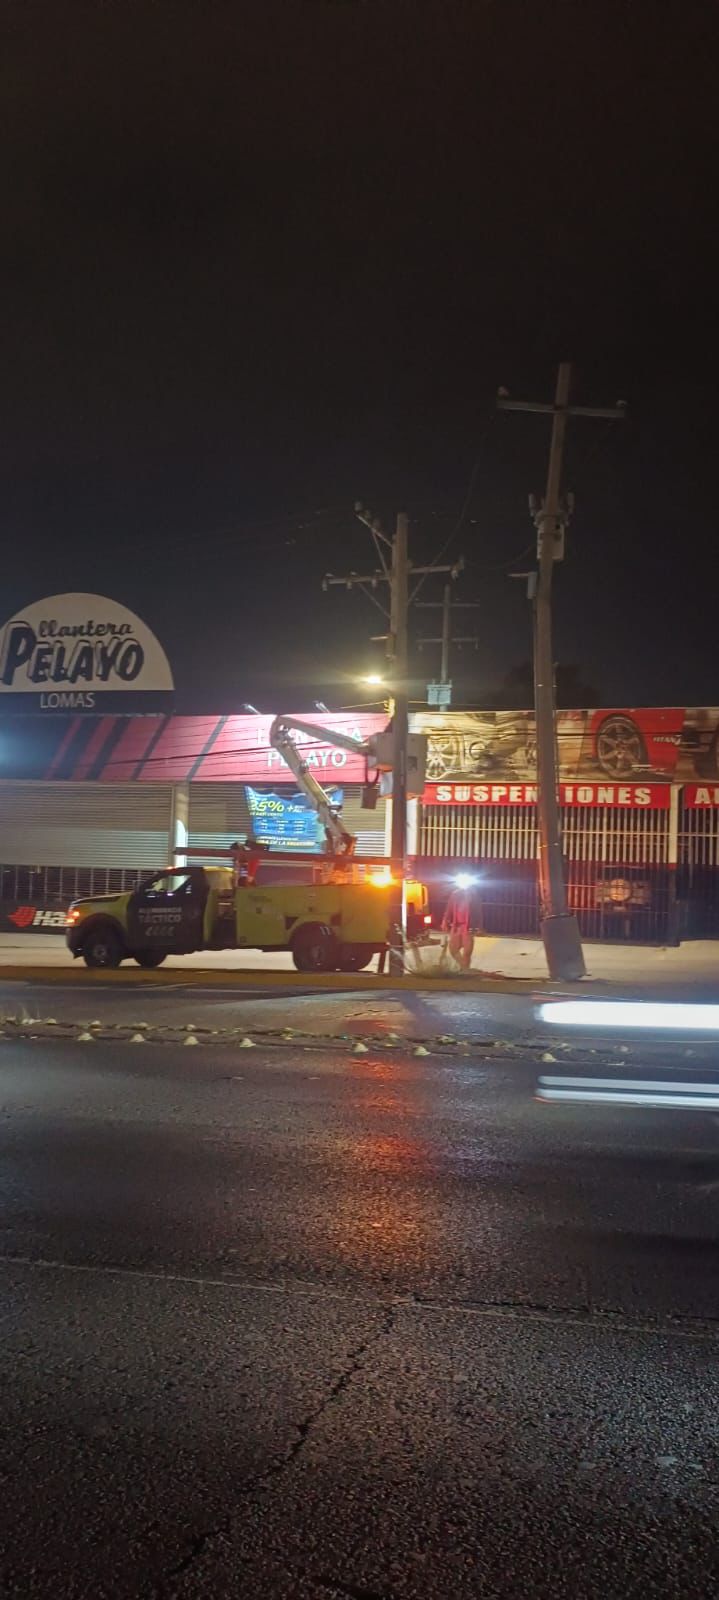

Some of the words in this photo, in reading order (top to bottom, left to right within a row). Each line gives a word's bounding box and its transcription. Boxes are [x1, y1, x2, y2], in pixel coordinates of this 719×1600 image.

[0, 621, 144, 685] PELAYO
[40, 693, 95, 708] LOMAS
[435, 785, 652, 805] SUSPENIONES
